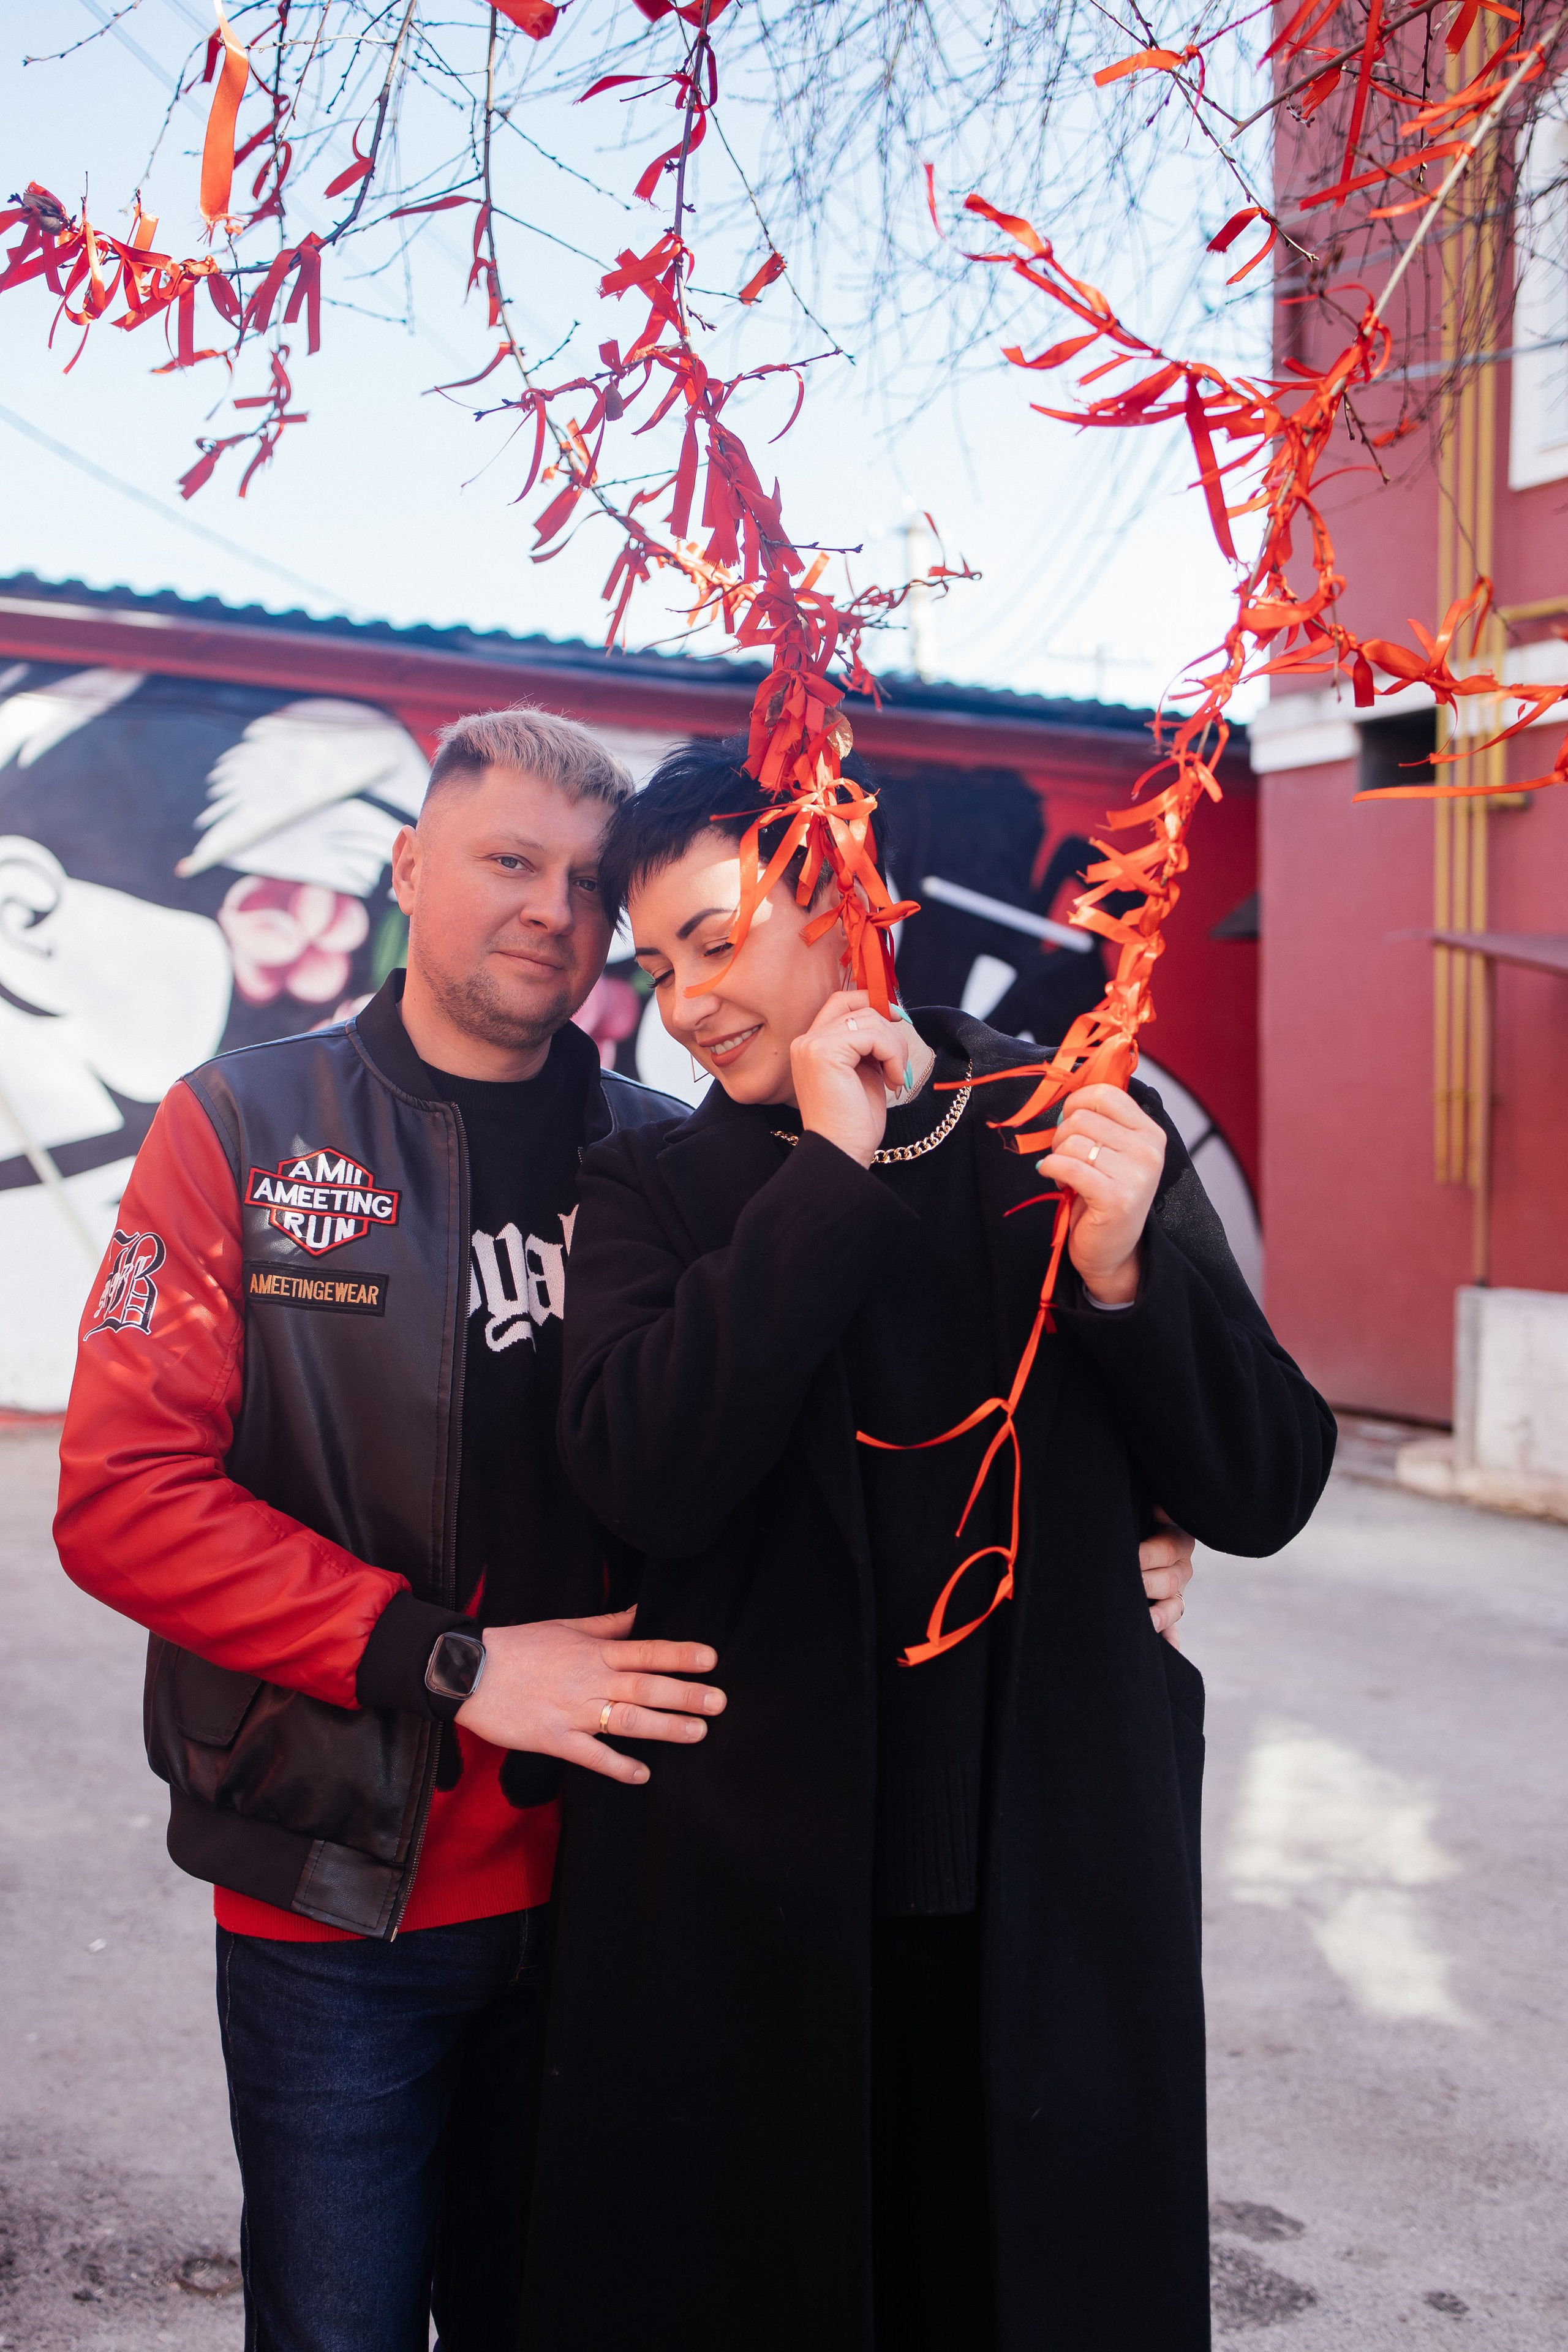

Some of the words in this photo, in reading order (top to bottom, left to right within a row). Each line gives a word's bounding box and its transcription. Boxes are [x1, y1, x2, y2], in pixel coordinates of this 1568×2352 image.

[253, 1178, 392, 1218] AMEETING
[284, 1212, 355, 1248] RUN
[250, 1273, 379, 1305] AMEETINGEWEAR
